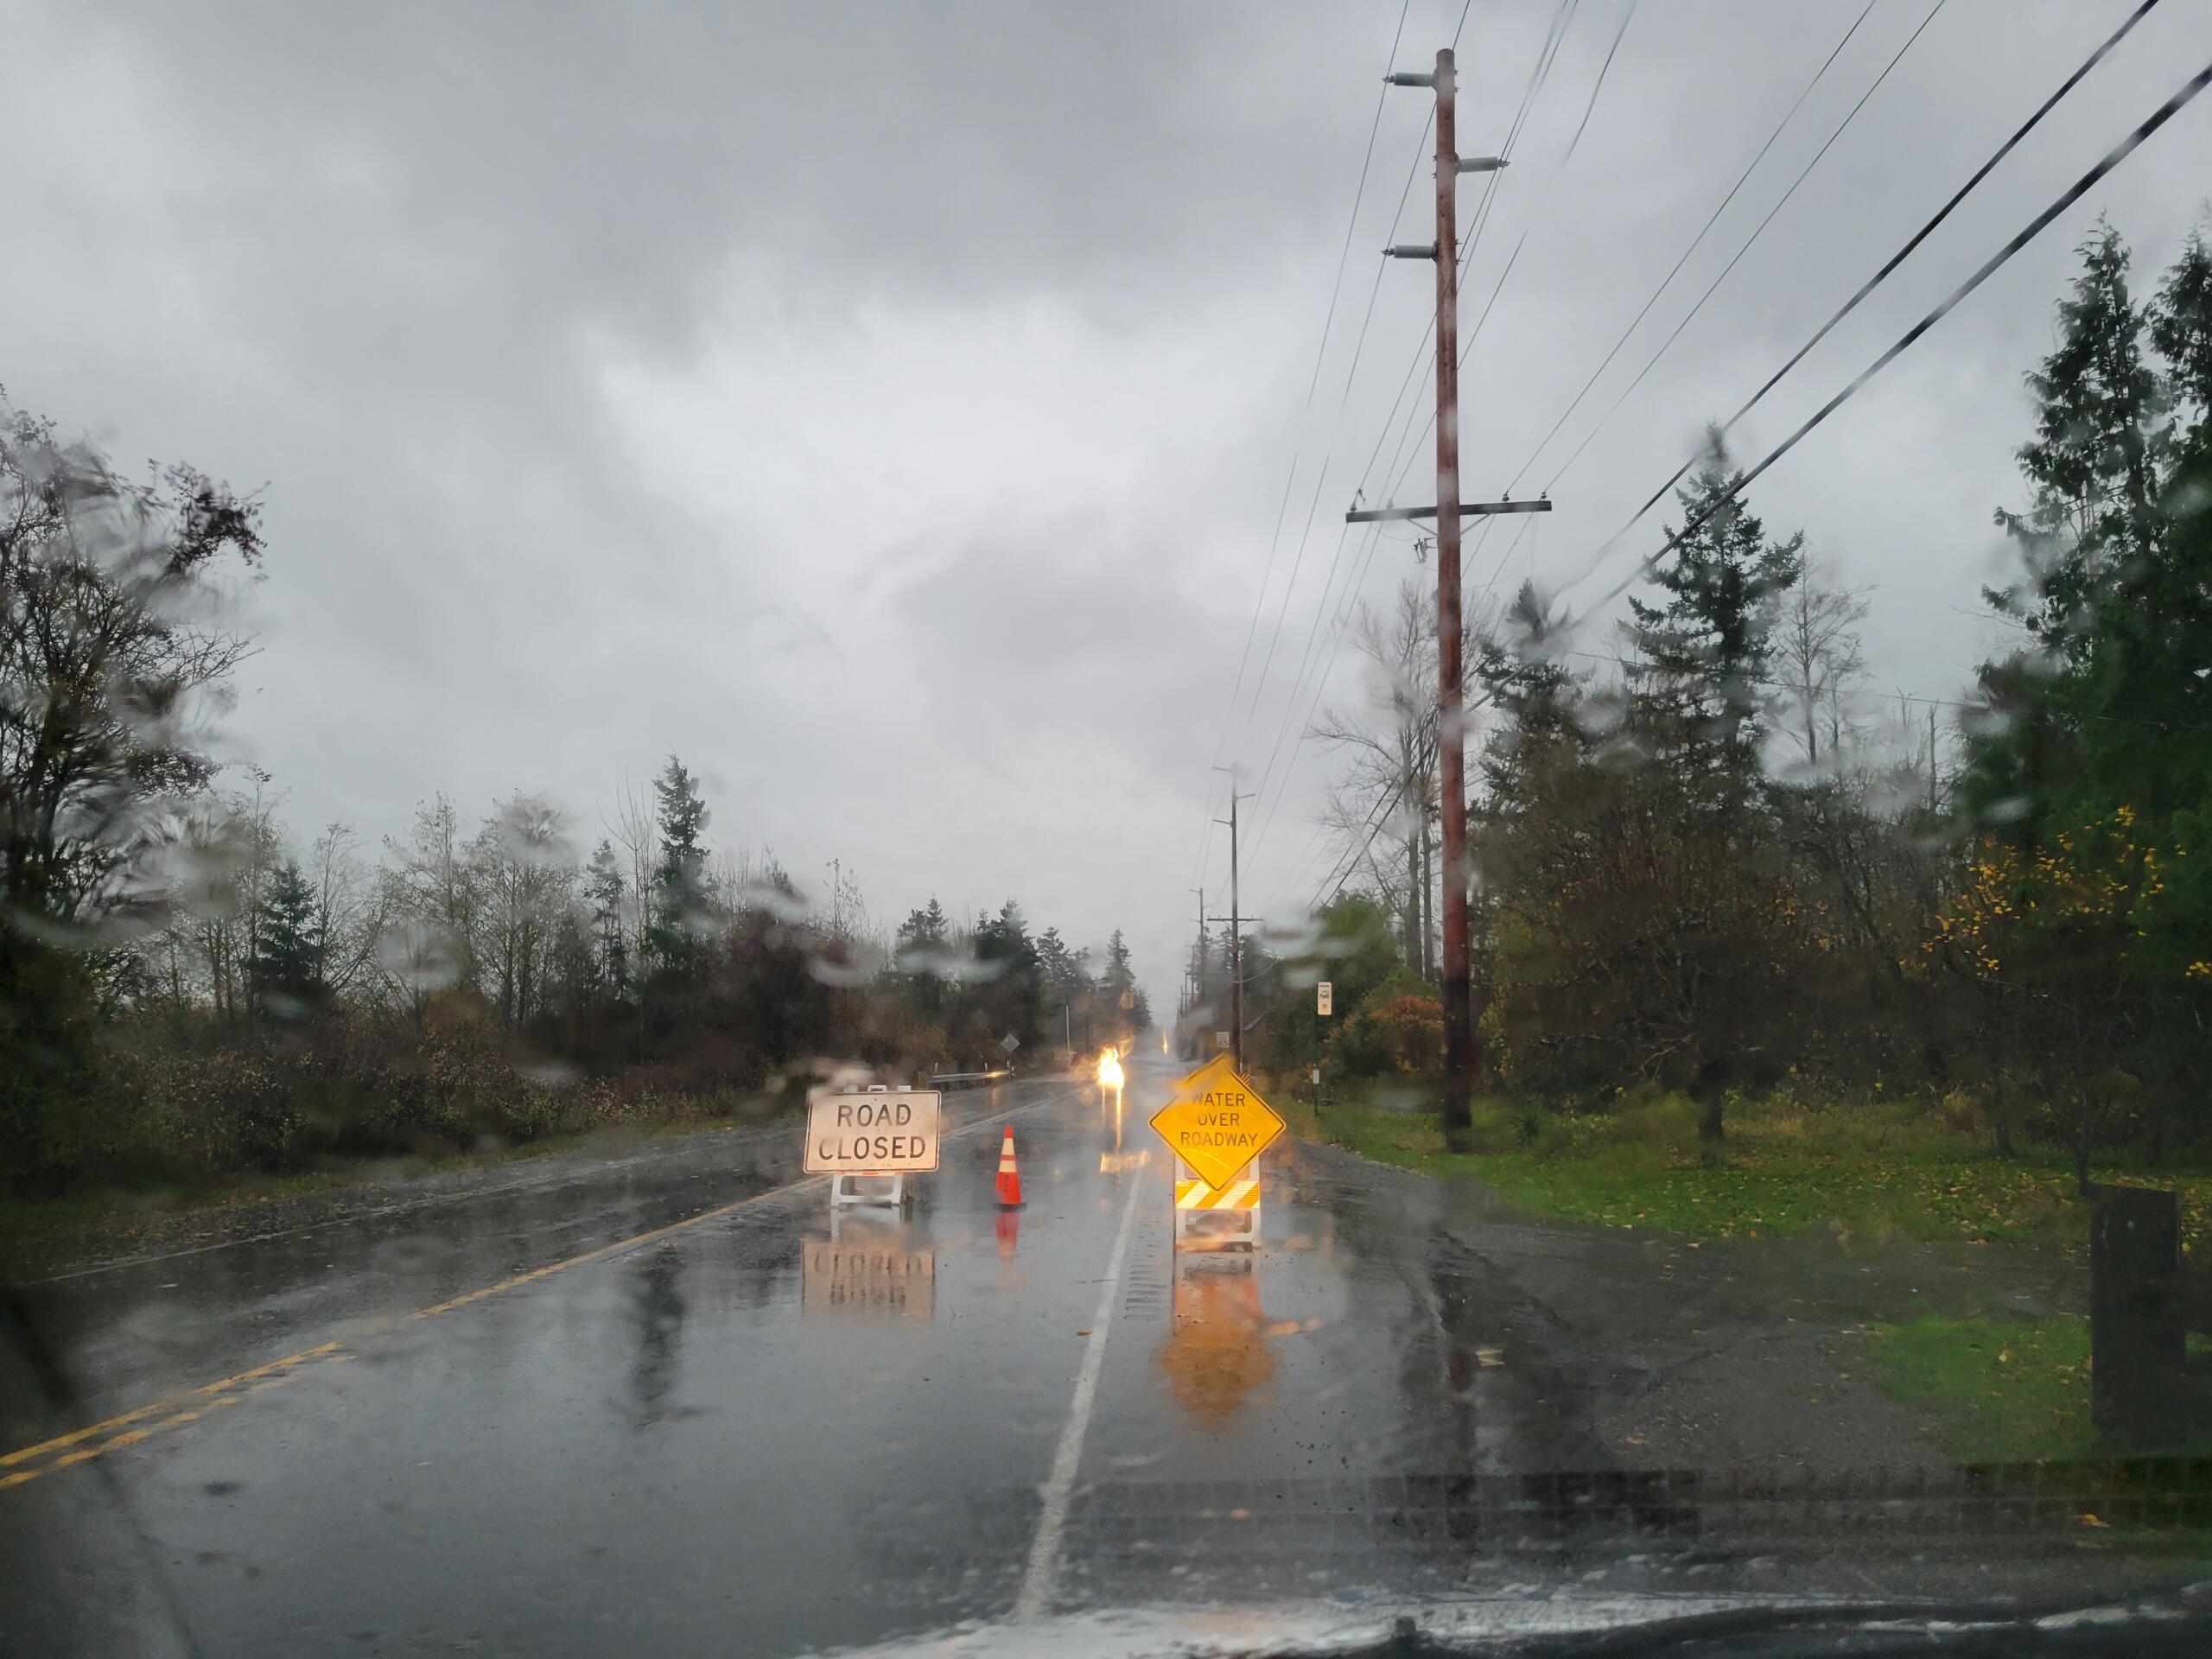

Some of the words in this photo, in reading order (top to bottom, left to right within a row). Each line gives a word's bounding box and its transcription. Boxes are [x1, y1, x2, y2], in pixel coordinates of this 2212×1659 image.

[836, 1104, 912, 1127] ROAD
[1198, 1113, 1240, 1126] OVER
[819, 1136, 926, 1160] CLOSED
[1180, 1131, 1258, 1147] ROADWAY
